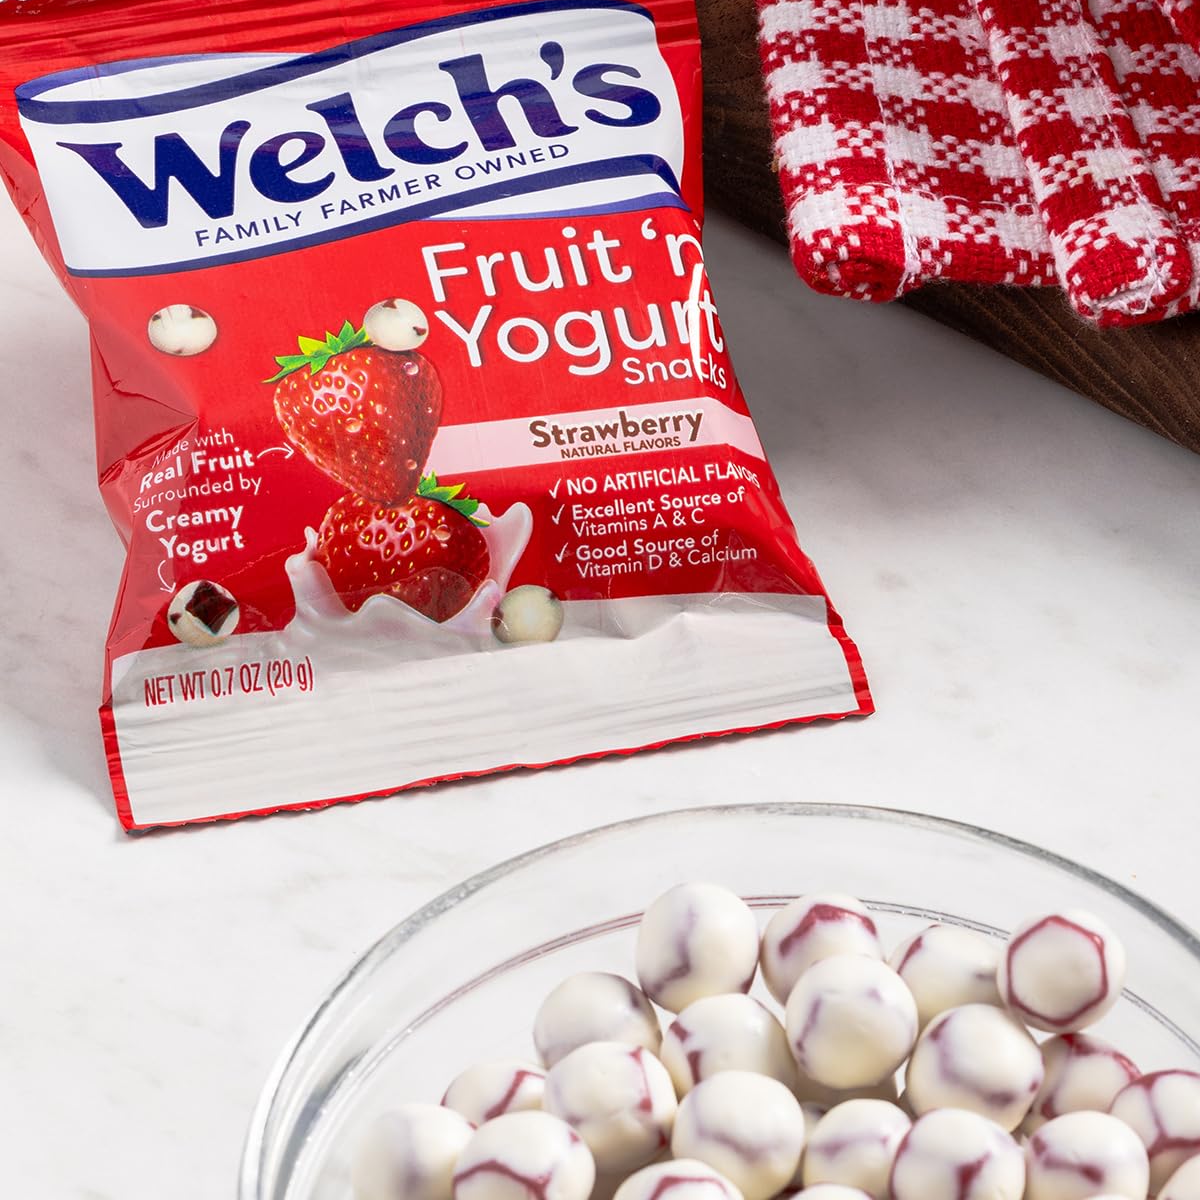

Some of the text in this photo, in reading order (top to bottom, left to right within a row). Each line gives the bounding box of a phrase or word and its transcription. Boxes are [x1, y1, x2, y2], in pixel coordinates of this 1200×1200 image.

[56, 40, 661, 228] Welch's
[195, 143, 570, 247] FAMILY FARMER OWNED
[421, 227, 632, 303] Fruit
[435, 290, 724, 376] Yogurt
[622, 353, 727, 390] Snacks
[528, 410, 703, 448] Strawberry
[560, 436, 681, 459] NATURAL FLAVORS
[151, 427, 235, 469] Made with
[140, 447, 255, 494] Real Fruit
[566, 462, 761, 496] NO ARTIFICIAL FLAVORS
[132, 472, 263, 514] Surrounded by
[571, 486, 745, 521] Excellent Source of
[145, 505, 244, 532] Creamy
[572, 507, 705, 538] Vitamins A & C
[159, 531, 245, 564] Yogurt
[575, 528, 719, 561] Good Source of
[576, 546, 758, 579] Vitamin D & Calcium
[144, 655, 314, 708] NET WT 0.7 OZ (20 g)
